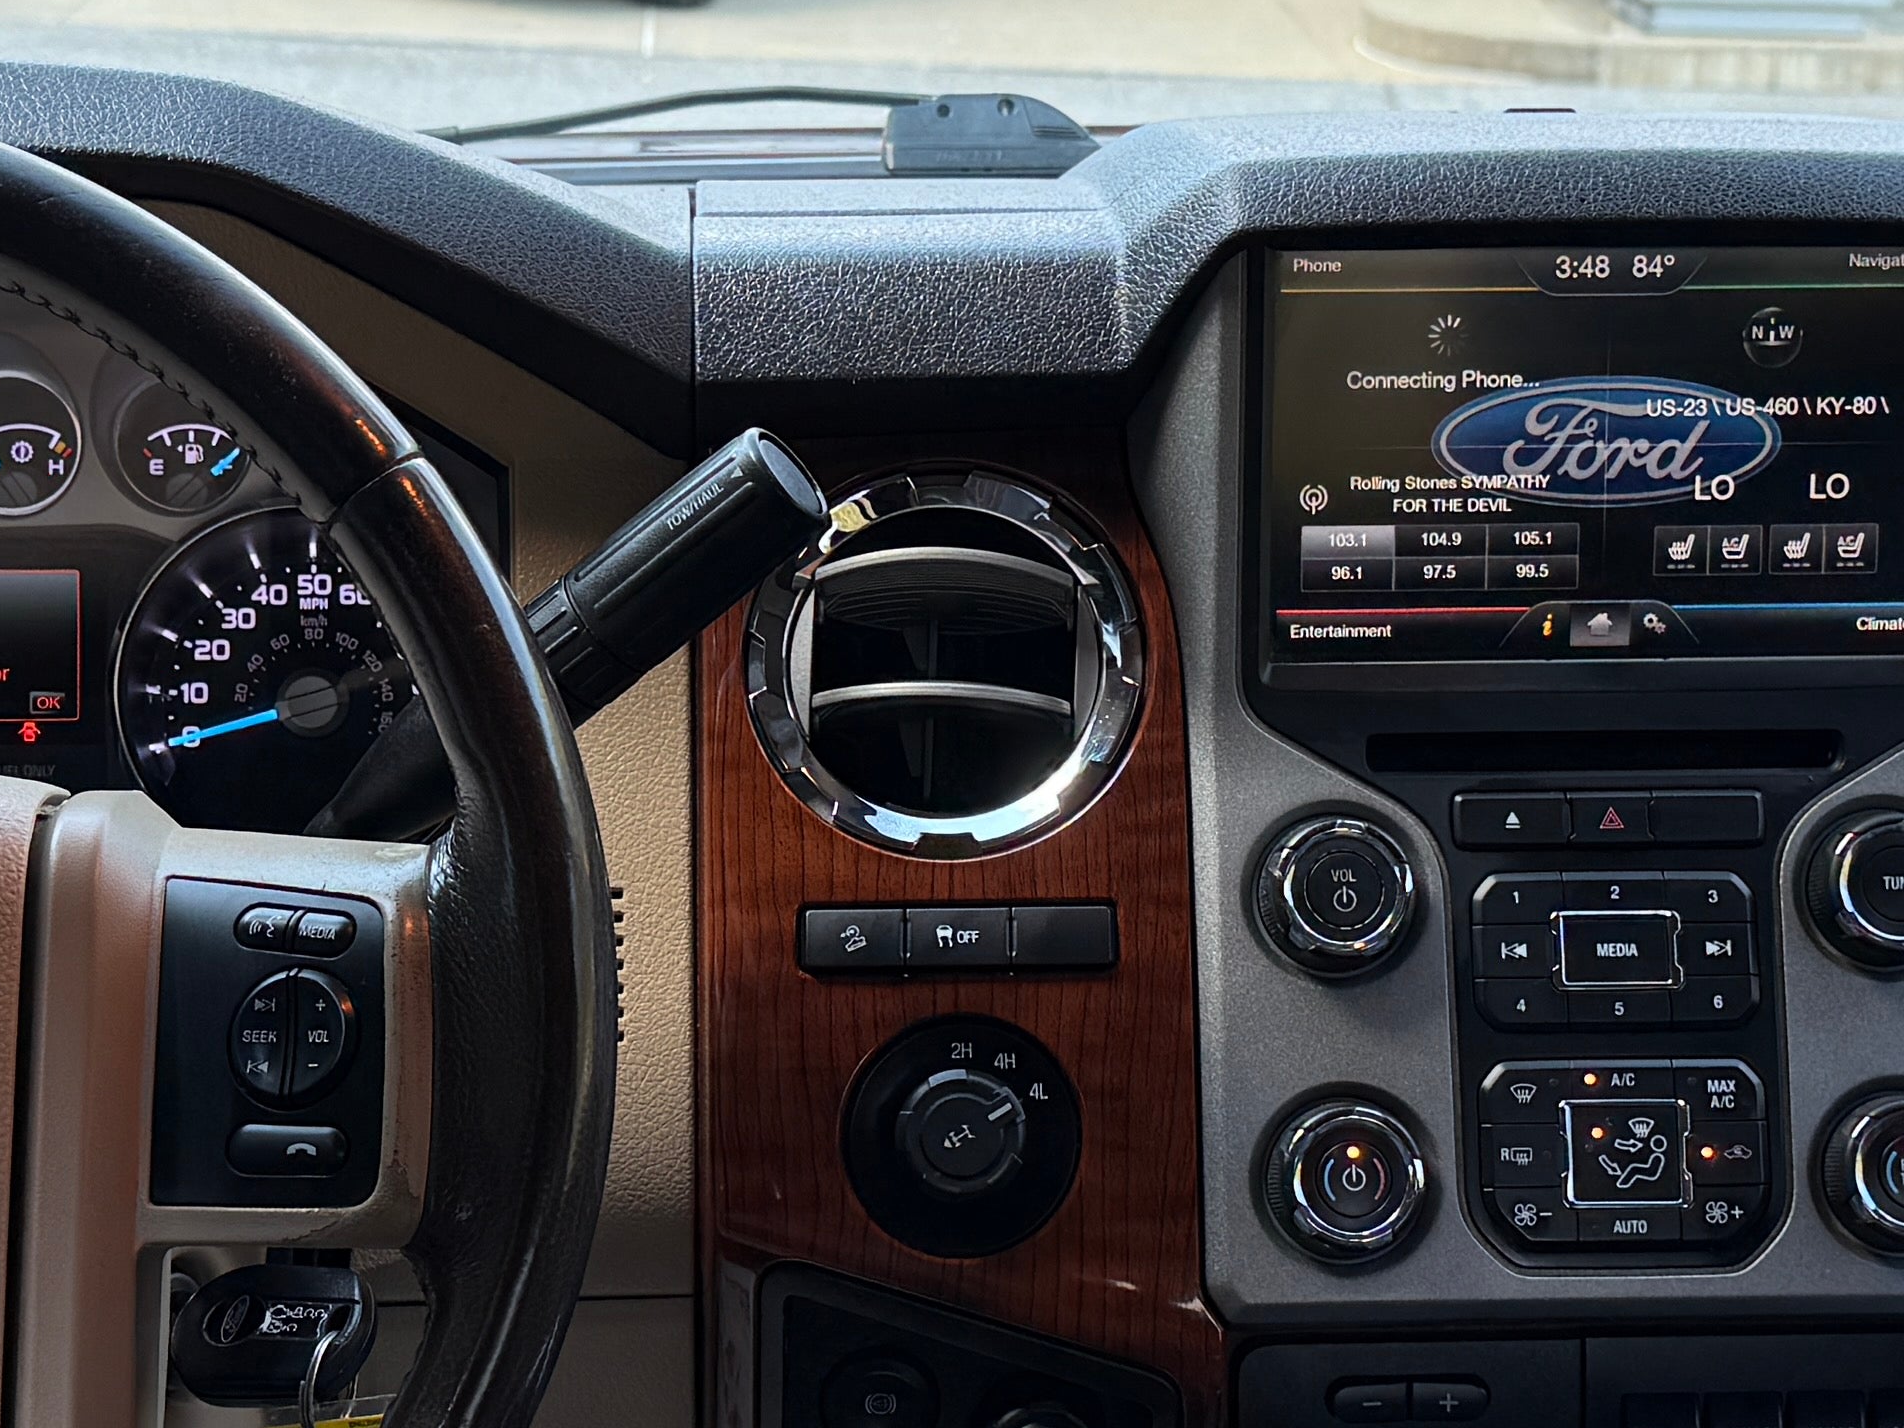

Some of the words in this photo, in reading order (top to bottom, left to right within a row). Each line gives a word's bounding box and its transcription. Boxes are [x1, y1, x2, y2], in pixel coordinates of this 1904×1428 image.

[1293, 258, 1342, 274] Phone
[1555, 256, 1611, 279] 3:48
[1632, 254, 1675, 278] 84°
[1346, 370, 1457, 392] Connecting
[1462, 370, 1540, 390] Phone...
[1646, 397, 1708, 417] US-23
[1725, 396, 1799, 417] US-460
[1815, 396, 1876, 416] KY-80
[1502, 397, 1708, 482] Ford
[49, 459, 64, 476] H
[149, 459, 164, 475] E
[1350, 474, 1400, 493] Rolling
[1404, 474, 1458, 492] Stones
[1461, 473, 1550, 491] SYMPATHY
[1694, 474, 1735, 501] LO
[1809, 473, 1850, 500] LO
[665, 481, 724, 532] TOW/HAUL
[1393, 498, 1424, 515] FOR
[1428, 498, 1462, 515] THE
[1466, 498, 1512, 514] DEVIL
[1328, 532, 1367, 548] 103.1
[1421, 531, 1462, 547] 104.9
[1513, 530, 1554, 547] 105.1
[1331, 565, 1363, 581] 96.1
[1423, 565, 1457, 580] 97.5
[1516, 563, 1549, 579] 99.5
[297, 574, 332, 595] 50
[251, 584, 288, 605] 40
[299, 597, 329, 610] MPH
[221, 607, 256, 629] 30
[300, 615, 328, 627] km/h
[304, 628, 324, 640] 80
[1289, 623, 1392, 641] Entertainment
[193, 639, 231, 661] 20
[270, 633, 291, 651] 60
[335, 632, 359, 651] 100
[246, 653, 264, 673] 40
[362, 649, 384, 674] 120
[180, 682, 209, 704] 10
[234, 683, 248, 703] 20
[380, 678, 394, 703] 140
[36, 696, 61, 710] OK
[1331, 868, 1357, 884] VOL
[1512, 890, 1521, 905] 1
[1610, 885, 1620, 901] 2
[1708, 888, 1719, 904] 3
[299, 924, 336, 941] MEDIA
[957, 929, 980, 946] OFF
[1596, 942, 1639, 959] MEDIA
[1516, 998, 1527, 1013] 4
[1614, 1001, 1625, 1017] 5
[1713, 995, 1723, 1011] 6
[242, 1029, 277, 1043] SEEK
[307, 1029, 329, 1043] VOL
[950, 1042, 973, 1061] 2H
[994, 1052, 1016, 1071] 4H
[1610, 1072, 1636, 1089] A/C
[1707, 1079, 1737, 1097] MAX
[1029, 1083, 1048, 1102] 4L
[1710, 1094, 1737, 1111] A/C
[1613, 1219, 1648, 1236] AUTO
